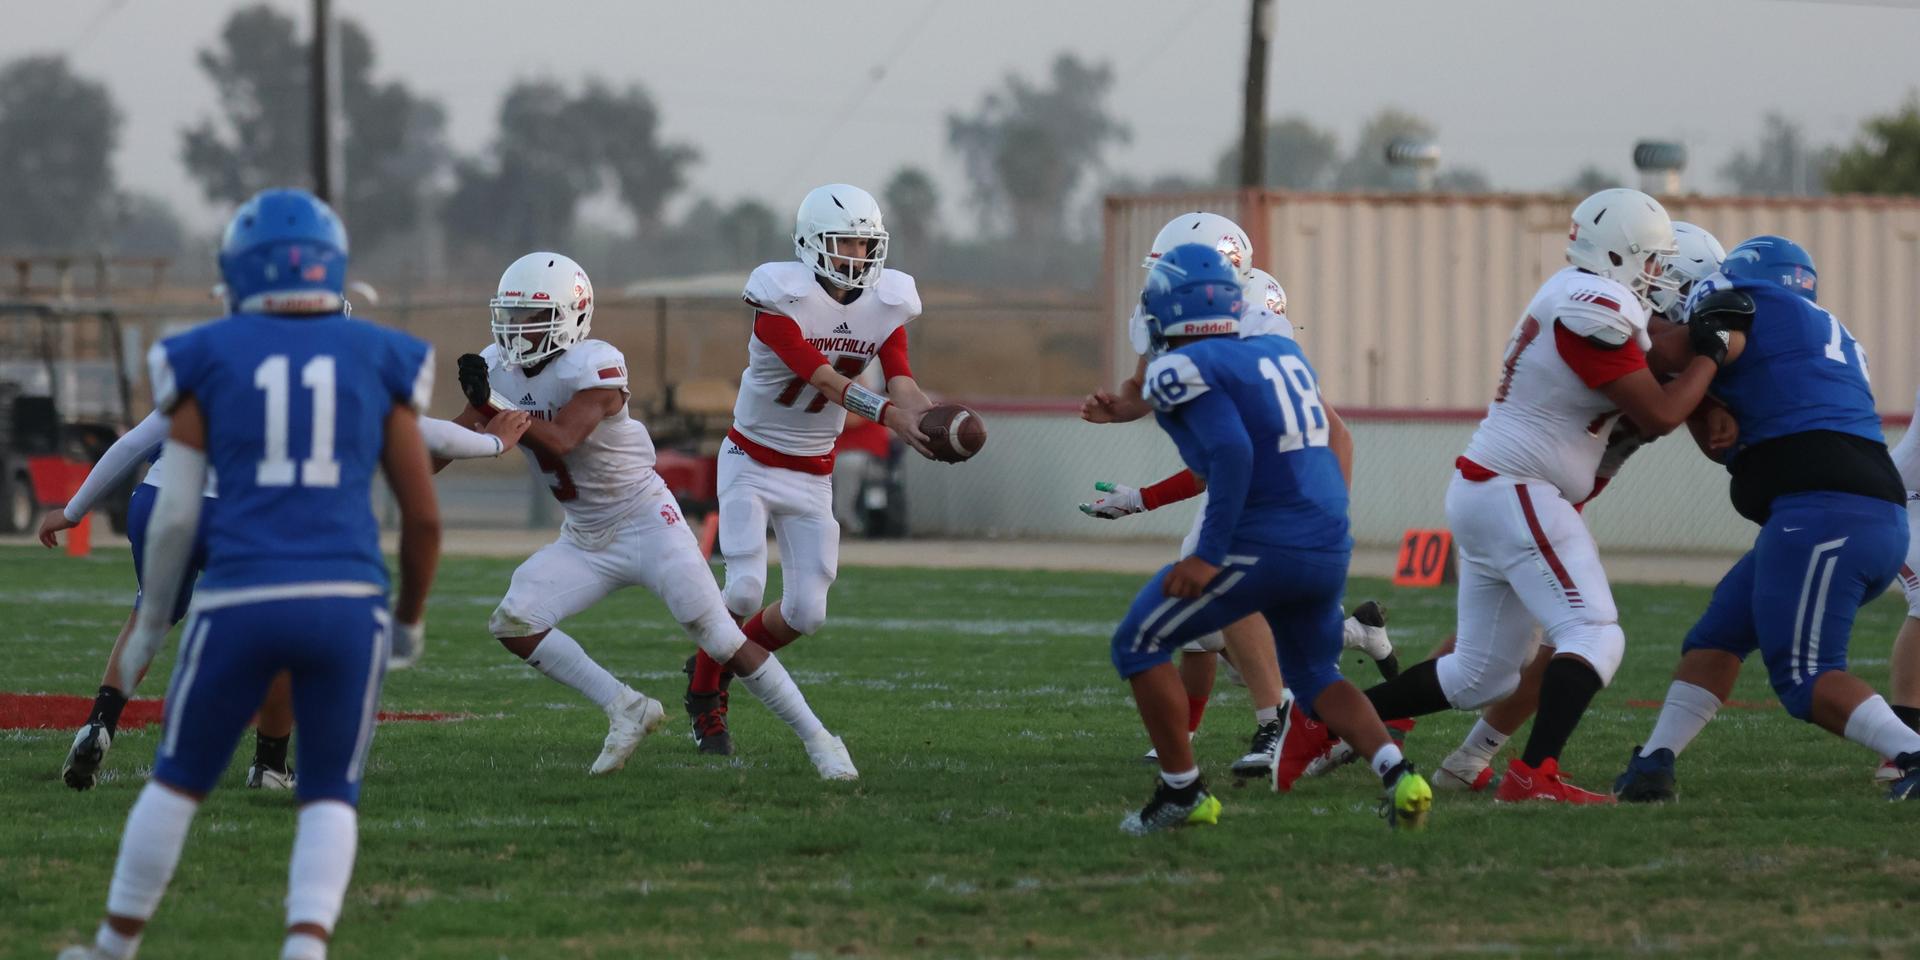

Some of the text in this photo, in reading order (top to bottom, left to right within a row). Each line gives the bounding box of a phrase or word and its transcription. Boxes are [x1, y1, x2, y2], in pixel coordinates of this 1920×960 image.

[1184, 321, 1233, 334] Riddell
[1150, 367, 1188, 408] 18
[1258, 355, 1330, 453] 18
[254, 354, 340, 487] 11
[1399, 534, 1441, 578] 10
